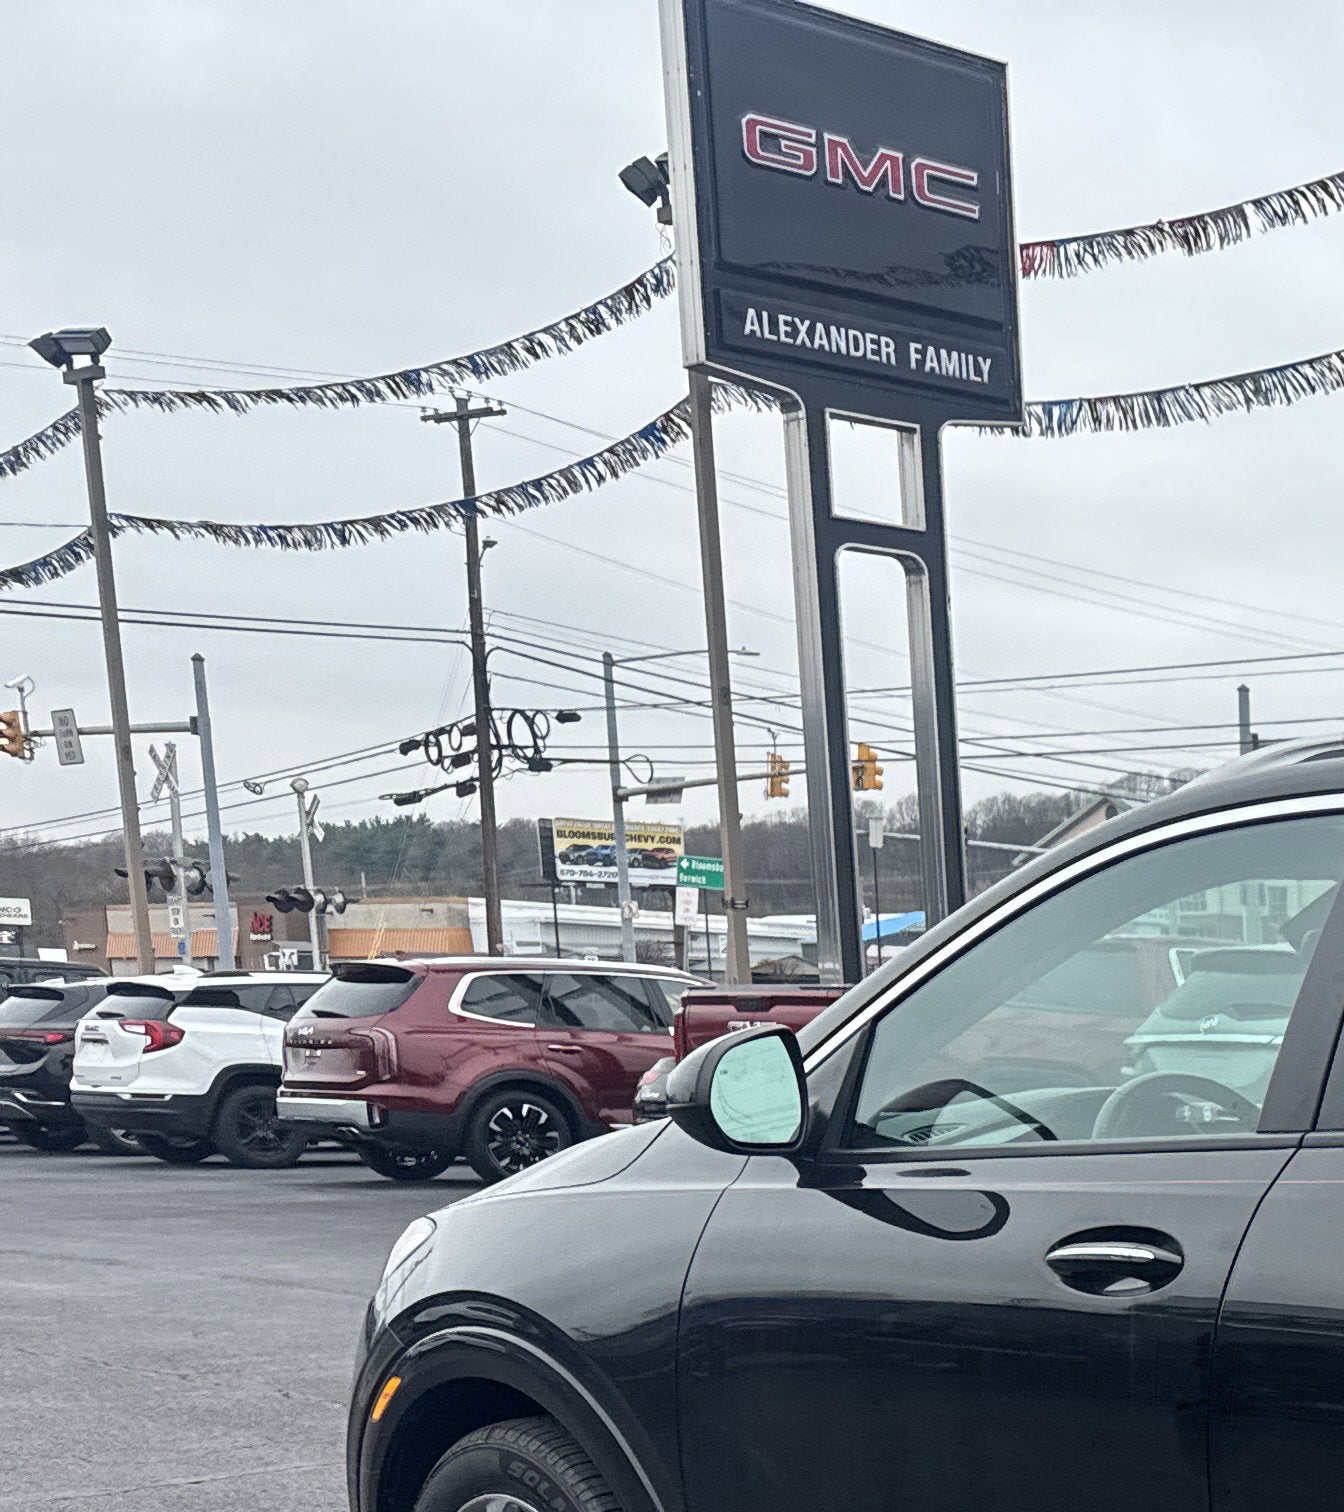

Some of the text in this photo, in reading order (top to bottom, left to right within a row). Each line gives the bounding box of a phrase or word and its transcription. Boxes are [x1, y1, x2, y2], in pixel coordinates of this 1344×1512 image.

[741, 113, 980, 219] GMC
[743, 307, 993, 385] ALEXANDER FAMILY
